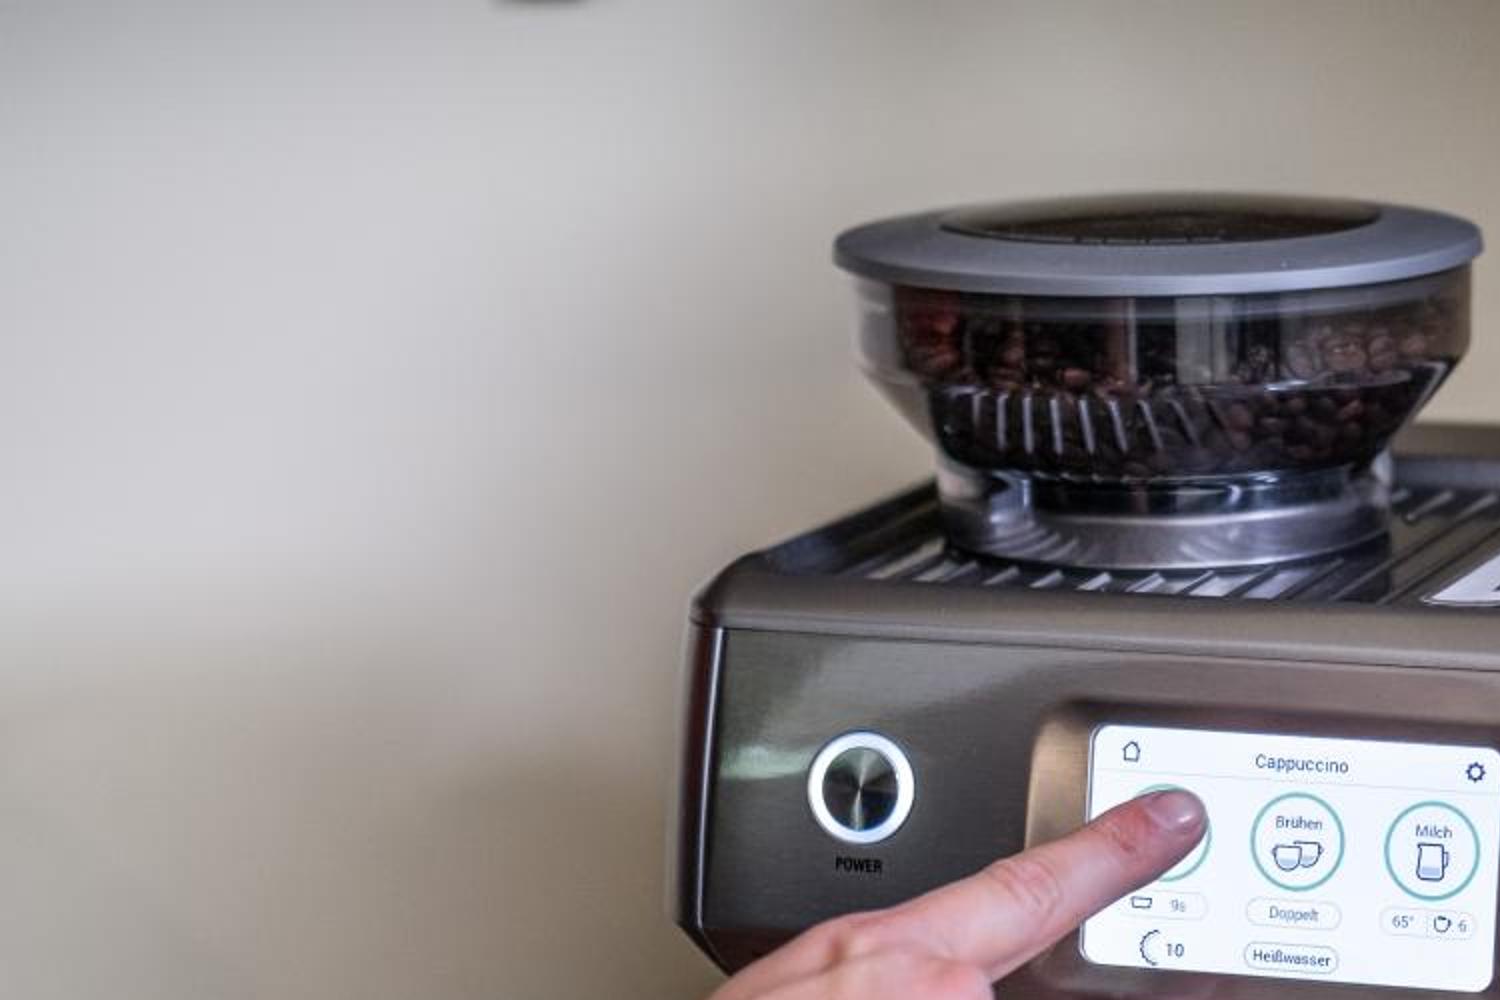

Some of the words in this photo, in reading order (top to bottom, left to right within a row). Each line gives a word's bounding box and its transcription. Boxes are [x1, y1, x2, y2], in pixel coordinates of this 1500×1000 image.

[1255, 753, 1349, 774] Cappuccino
[1415, 824, 1453, 839] Milch
[835, 856, 883, 873] POWER
[1268, 905, 1320, 923] Doppelt
[1166, 943, 1185, 958] 10
[1252, 948, 1331, 966] Heißwasser
